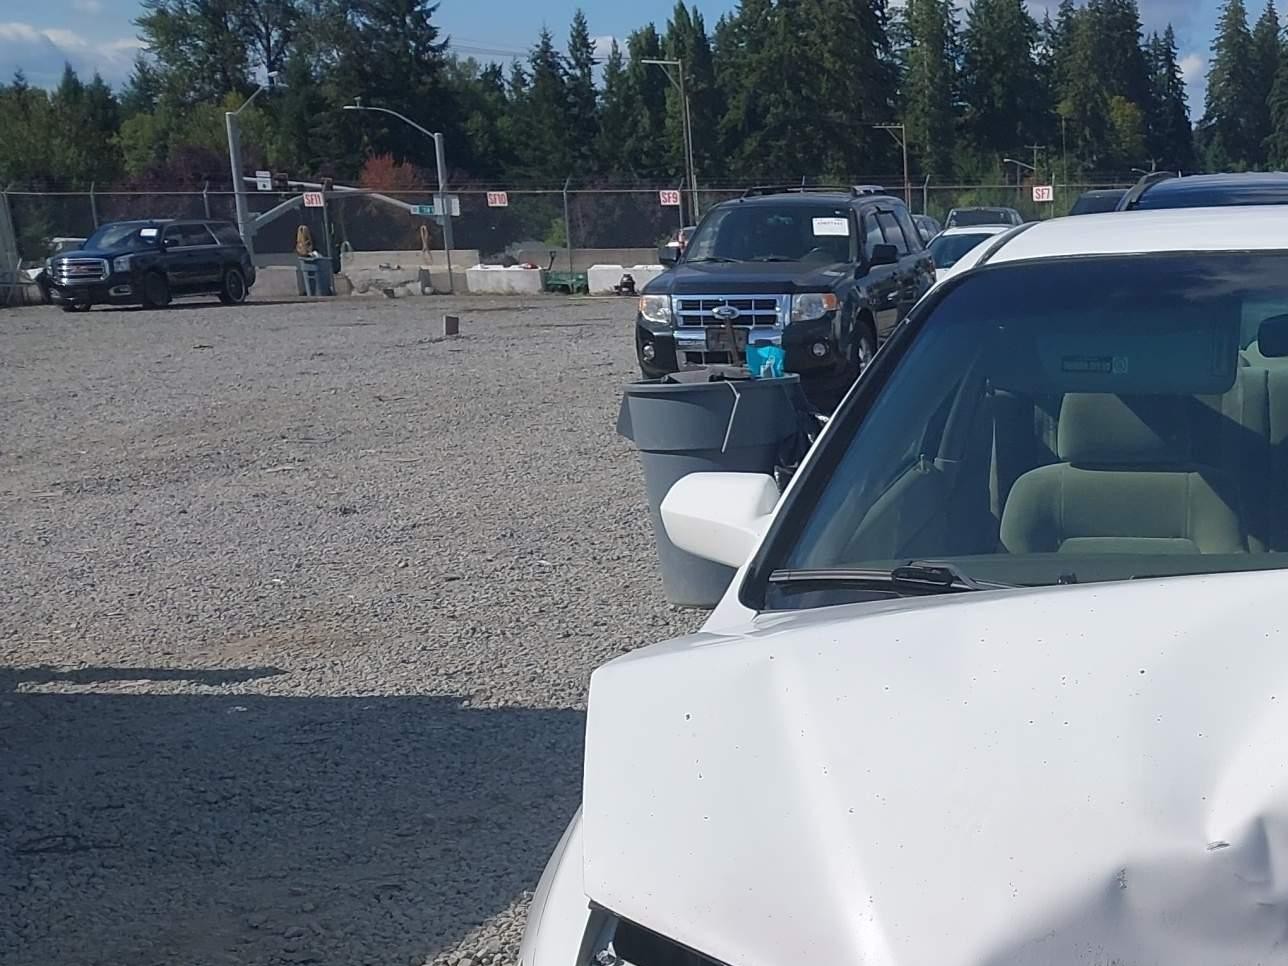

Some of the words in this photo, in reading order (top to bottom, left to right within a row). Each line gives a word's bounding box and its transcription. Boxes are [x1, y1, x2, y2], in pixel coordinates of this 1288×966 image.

[488, 193, 506, 205] SF10
[661, 191, 678, 204] SF9
[1034, 187, 1050, 200] SF7
